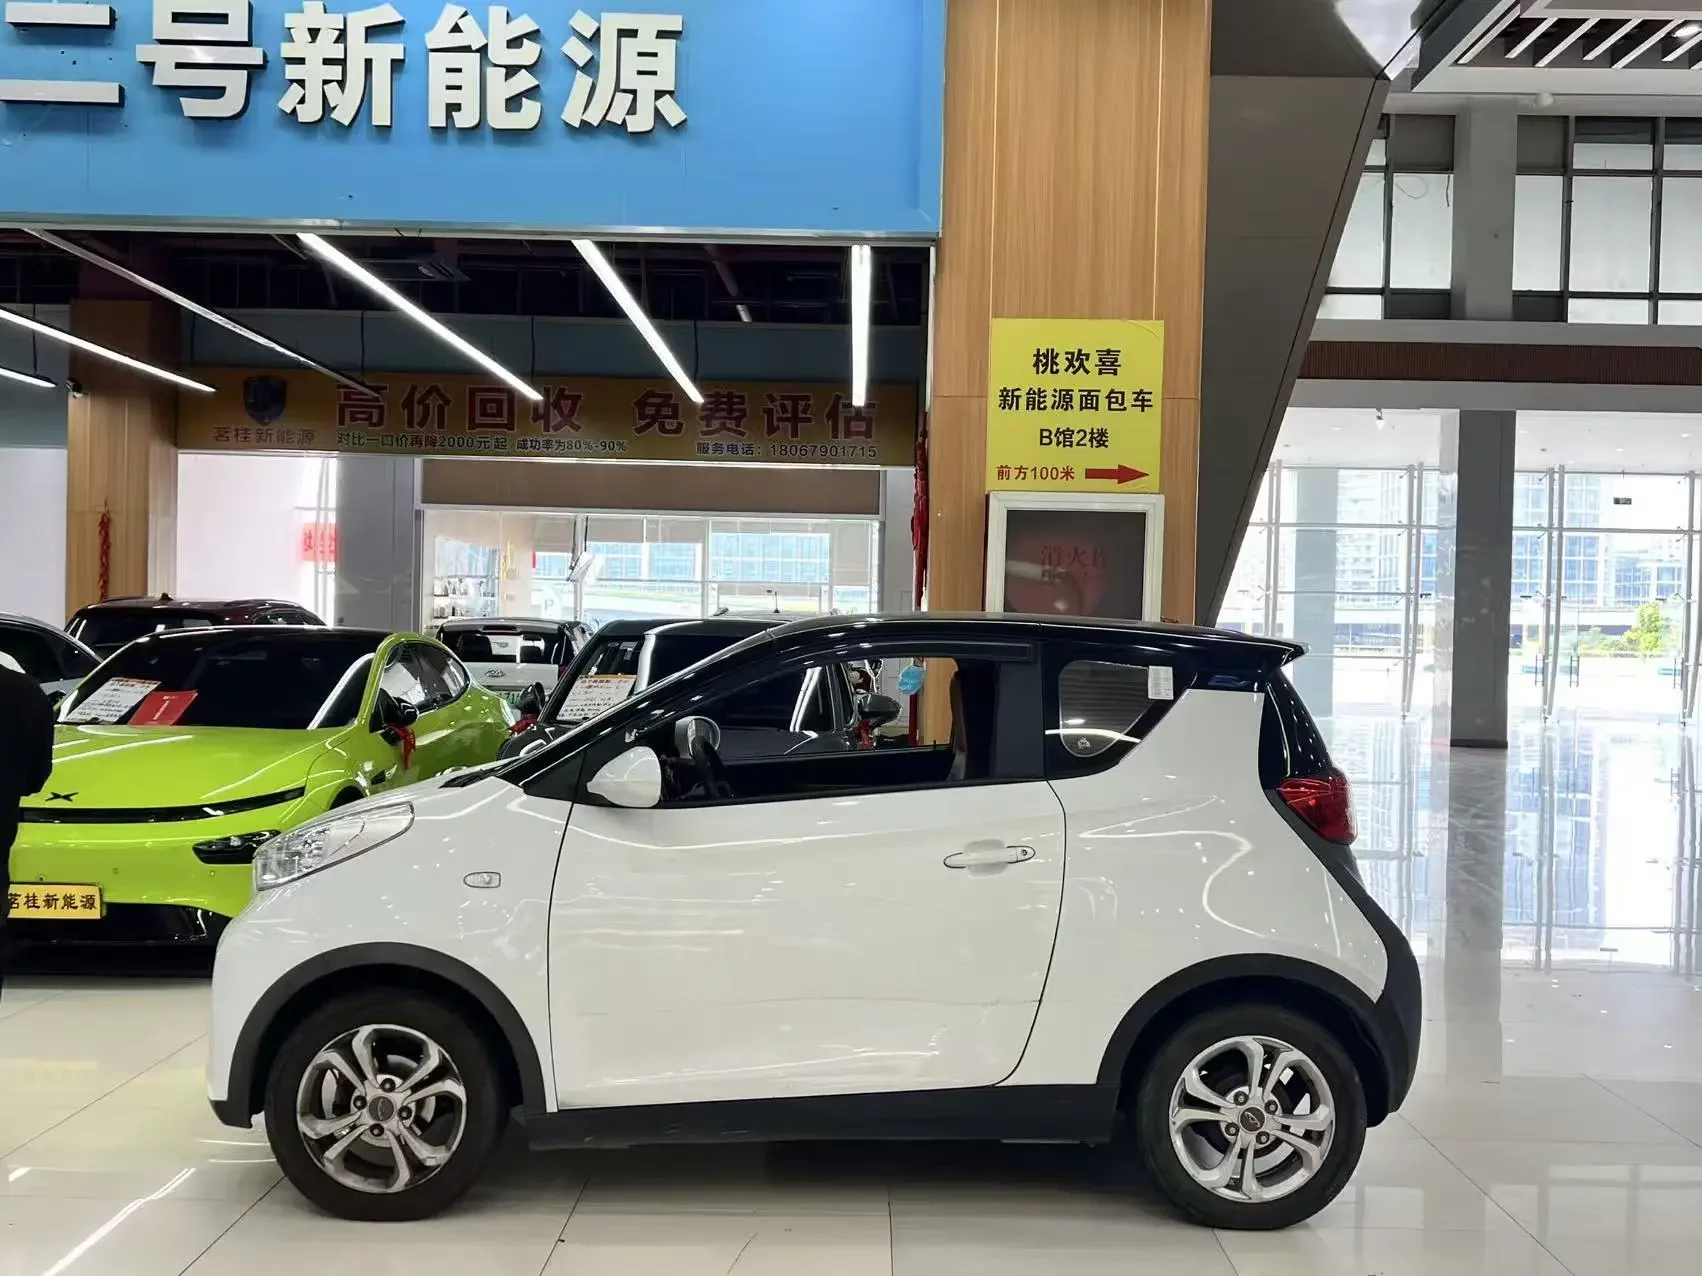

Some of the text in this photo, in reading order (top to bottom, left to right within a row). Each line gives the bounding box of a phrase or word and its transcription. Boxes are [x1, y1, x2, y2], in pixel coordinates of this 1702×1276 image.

[1032, 348, 1122, 376] 桃欢喜
[336, 383, 879, 440] 高价回收 免费评估
[998, 387, 1153, 413] 新能源面包车
[212, 427, 318, 446] 茗桂新能源
[337, 431, 627, 454] 对比一口价再降2000元起 成功率为80%-90%
[1039, 428, 1109, 448] B馆2楼
[996, 465, 1075, 481] 前方100米
